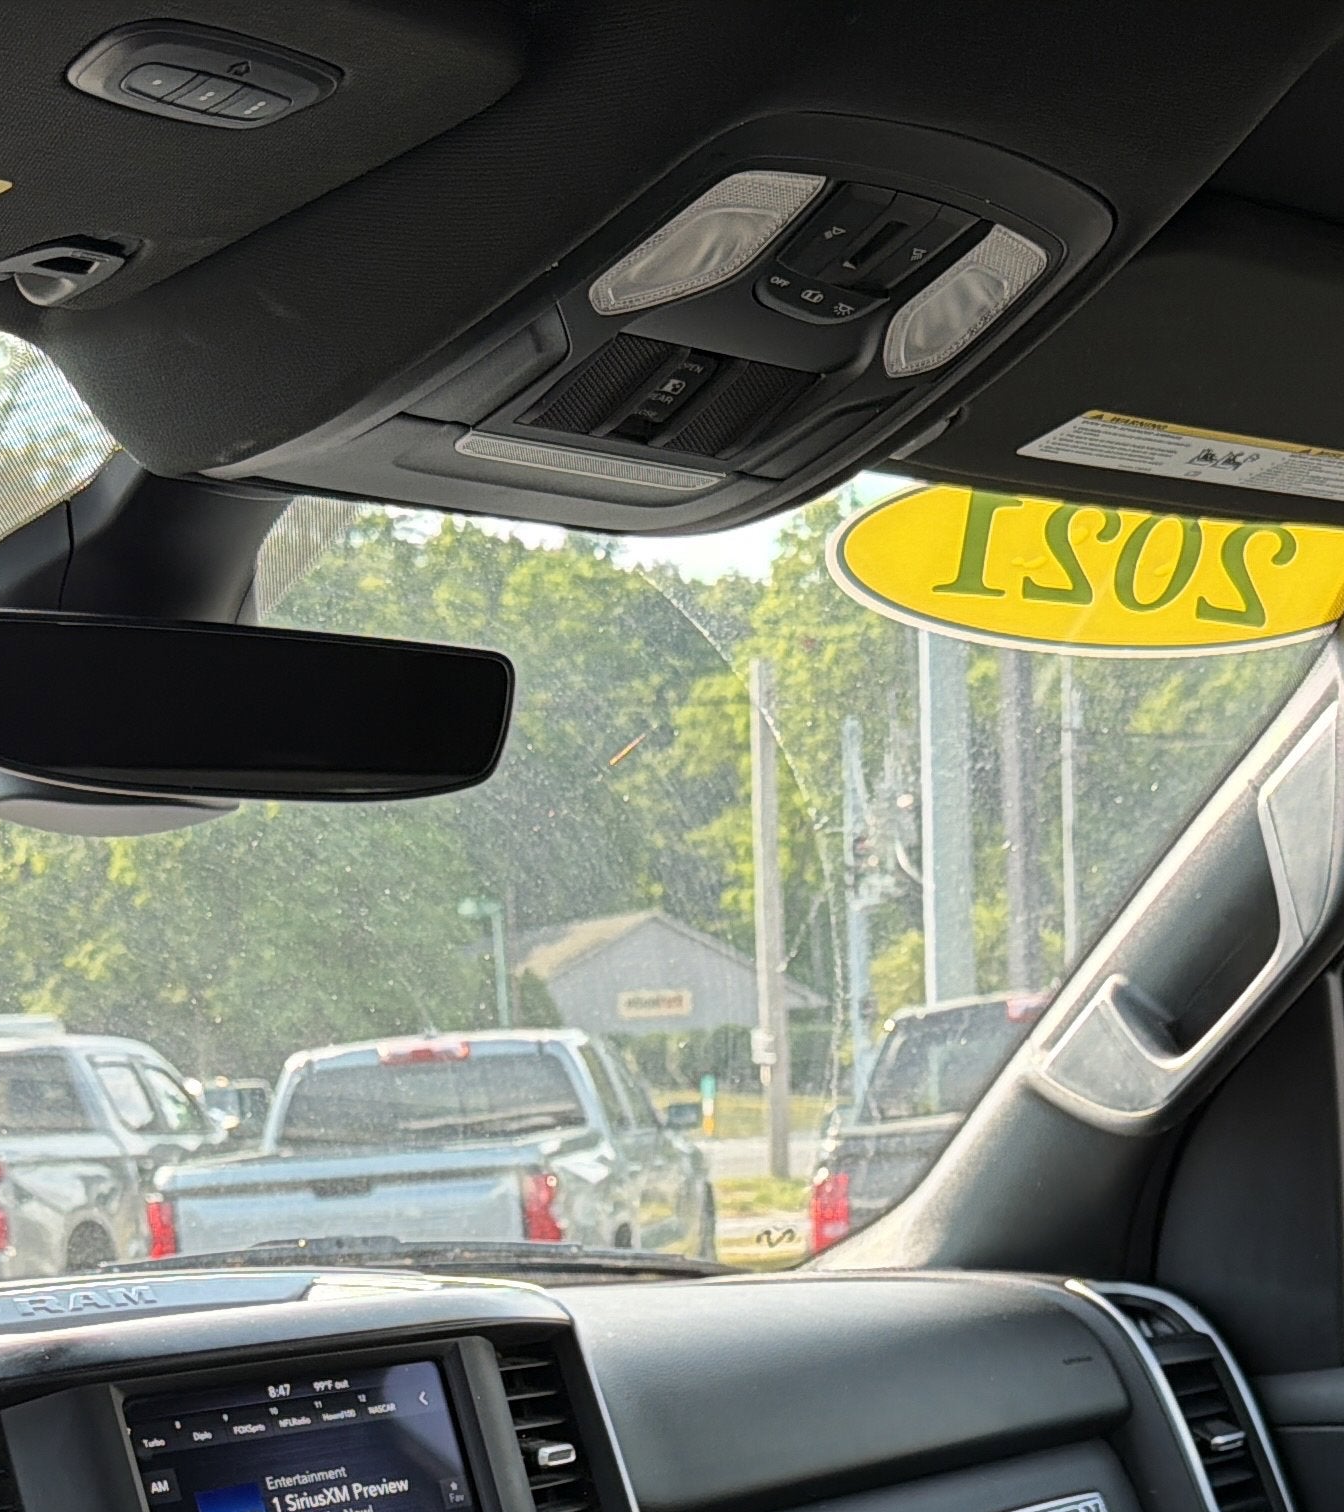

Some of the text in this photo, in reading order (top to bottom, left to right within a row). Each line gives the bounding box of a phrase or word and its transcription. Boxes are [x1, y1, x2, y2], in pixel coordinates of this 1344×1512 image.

[769, 276, 791, 288] OFF
[14, 1284, 158, 1317] RAM
[266, 1383, 290, 1399] 8:47
[367, 1402, 397, 1415] NASCAR
[265, 1466, 348, 1490] Entertainment
[150, 1480, 170, 1495] AM
[285, 1484, 351, 1512] SiriusXM
[352, 1478, 410, 1501] Preview
[449, 1492, 465, 1504] Fav
